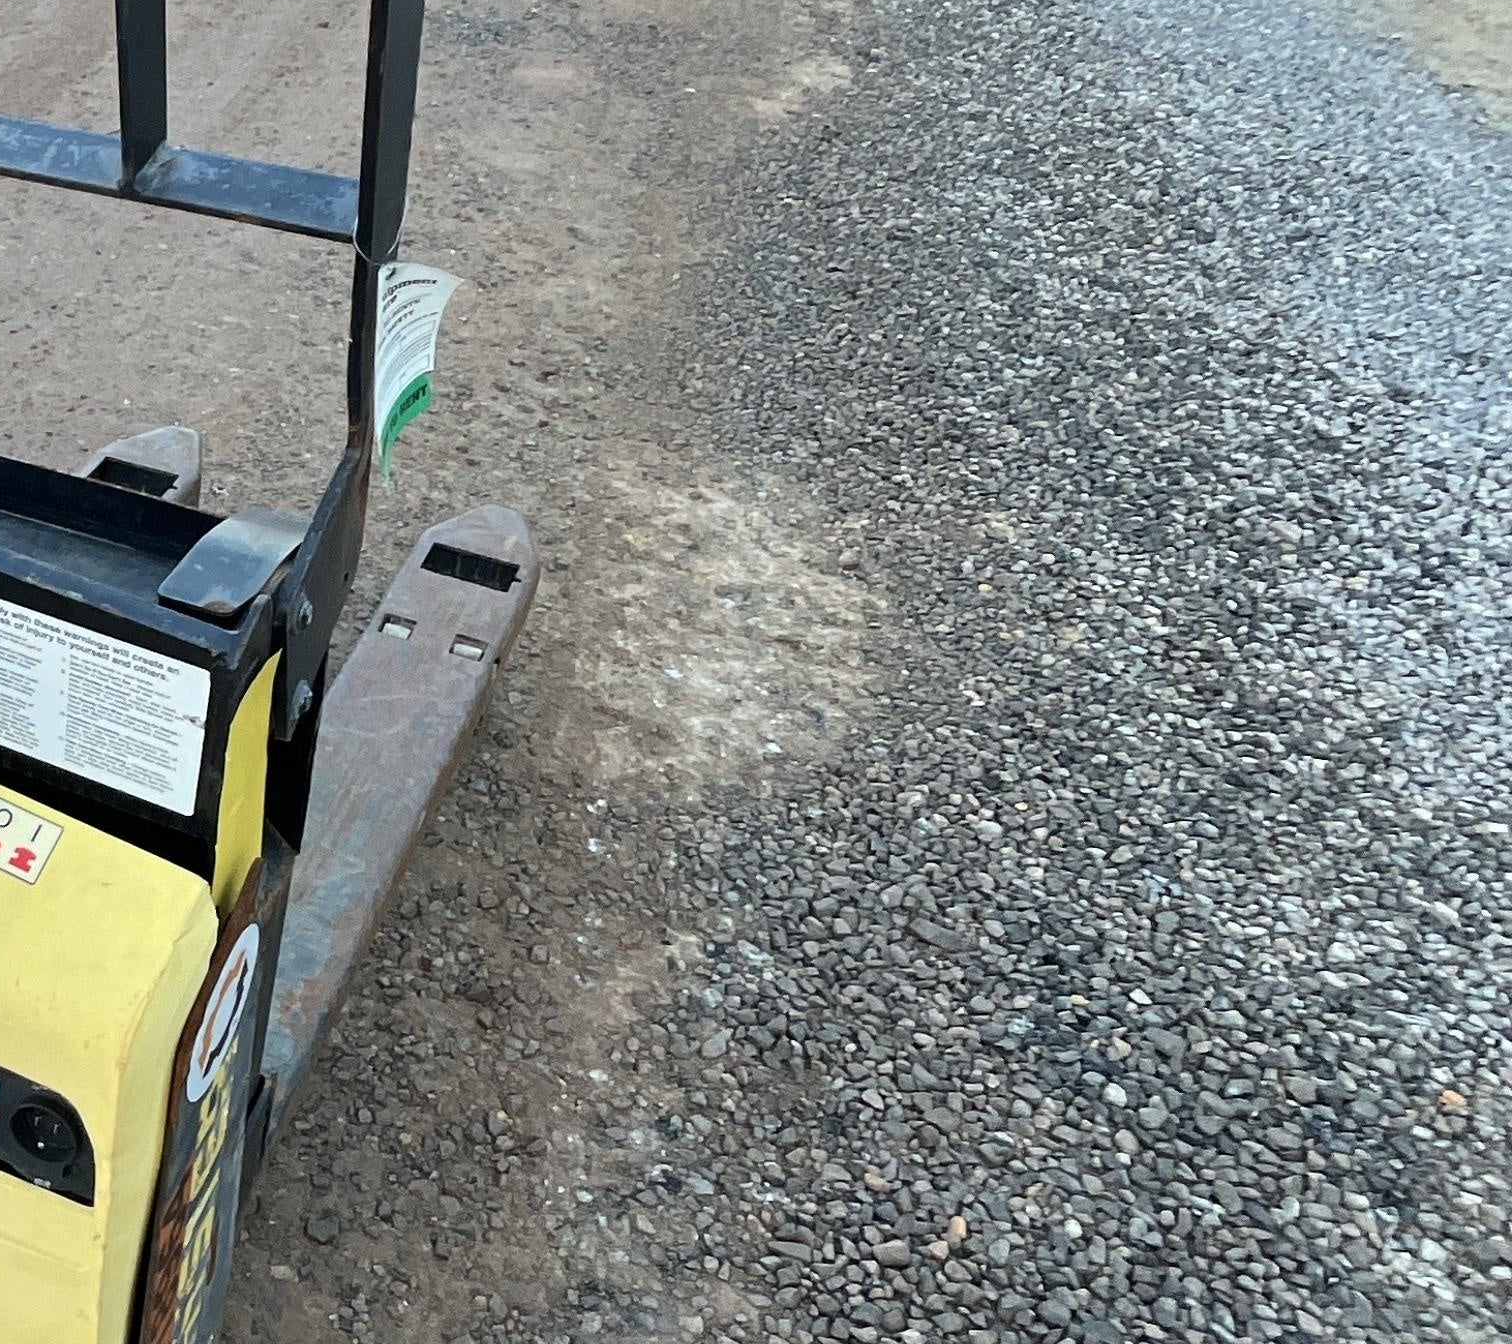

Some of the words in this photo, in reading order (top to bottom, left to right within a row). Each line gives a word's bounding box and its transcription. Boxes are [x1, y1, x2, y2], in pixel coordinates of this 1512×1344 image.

[11, 611, 32, 624] with
[33, 618, 61, 634] these
[63, 630, 110, 651] warnings
[112, 646, 130, 658] will
[131, 654, 164, 670] create
[166, 665, 180, 676] an
[26, 625, 55, 643] injury
[56, 636, 67, 646] to
[68, 641, 110, 660] yourself
[111, 657, 131, 669] and
